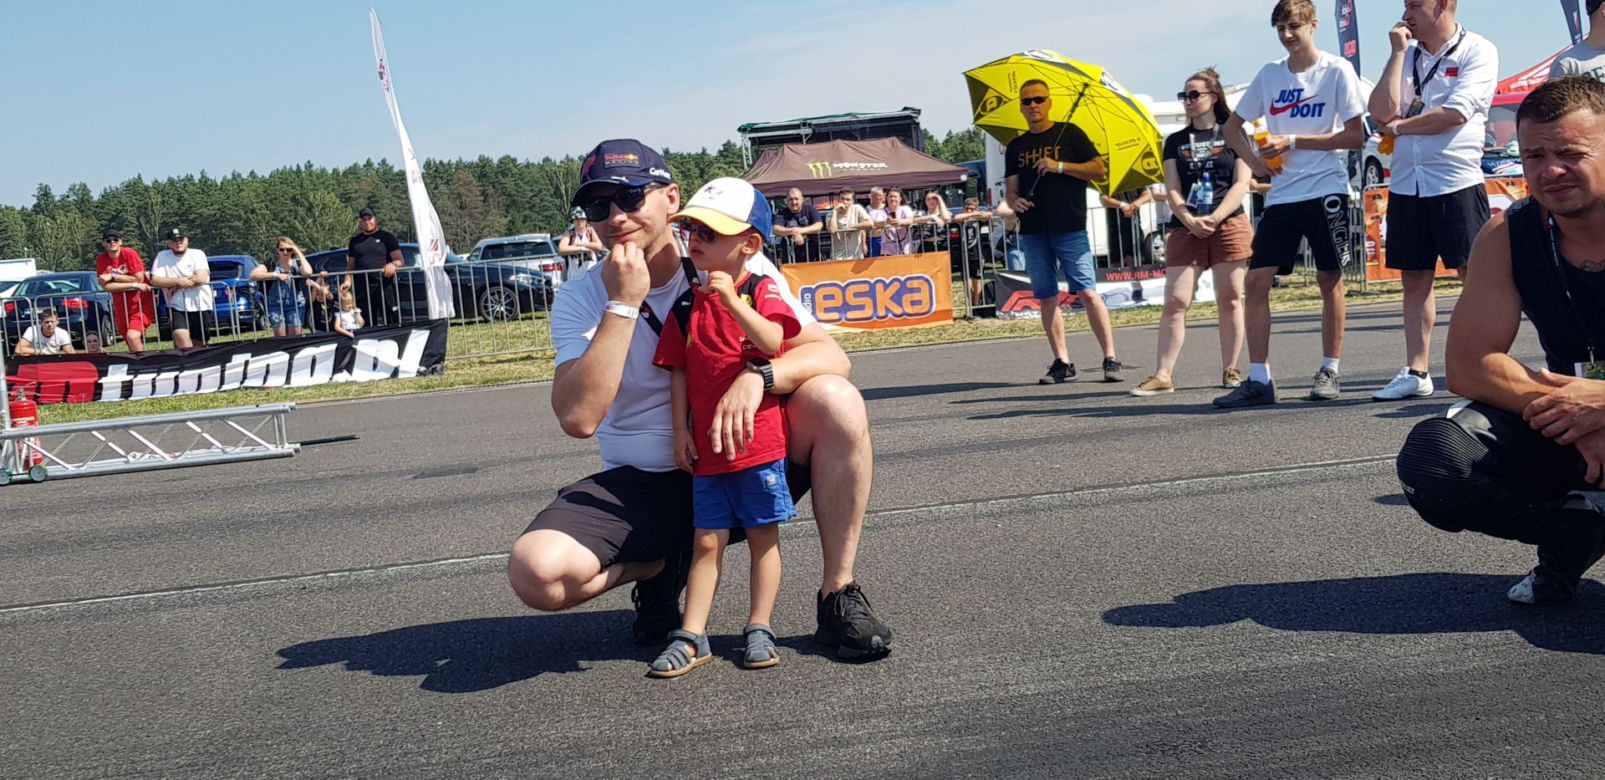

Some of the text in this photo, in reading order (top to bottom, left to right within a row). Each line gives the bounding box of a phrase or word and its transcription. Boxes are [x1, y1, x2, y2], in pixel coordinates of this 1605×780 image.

[1275, 88, 1304, 103] JUST
[1290, 103, 1325, 118] DO IT
